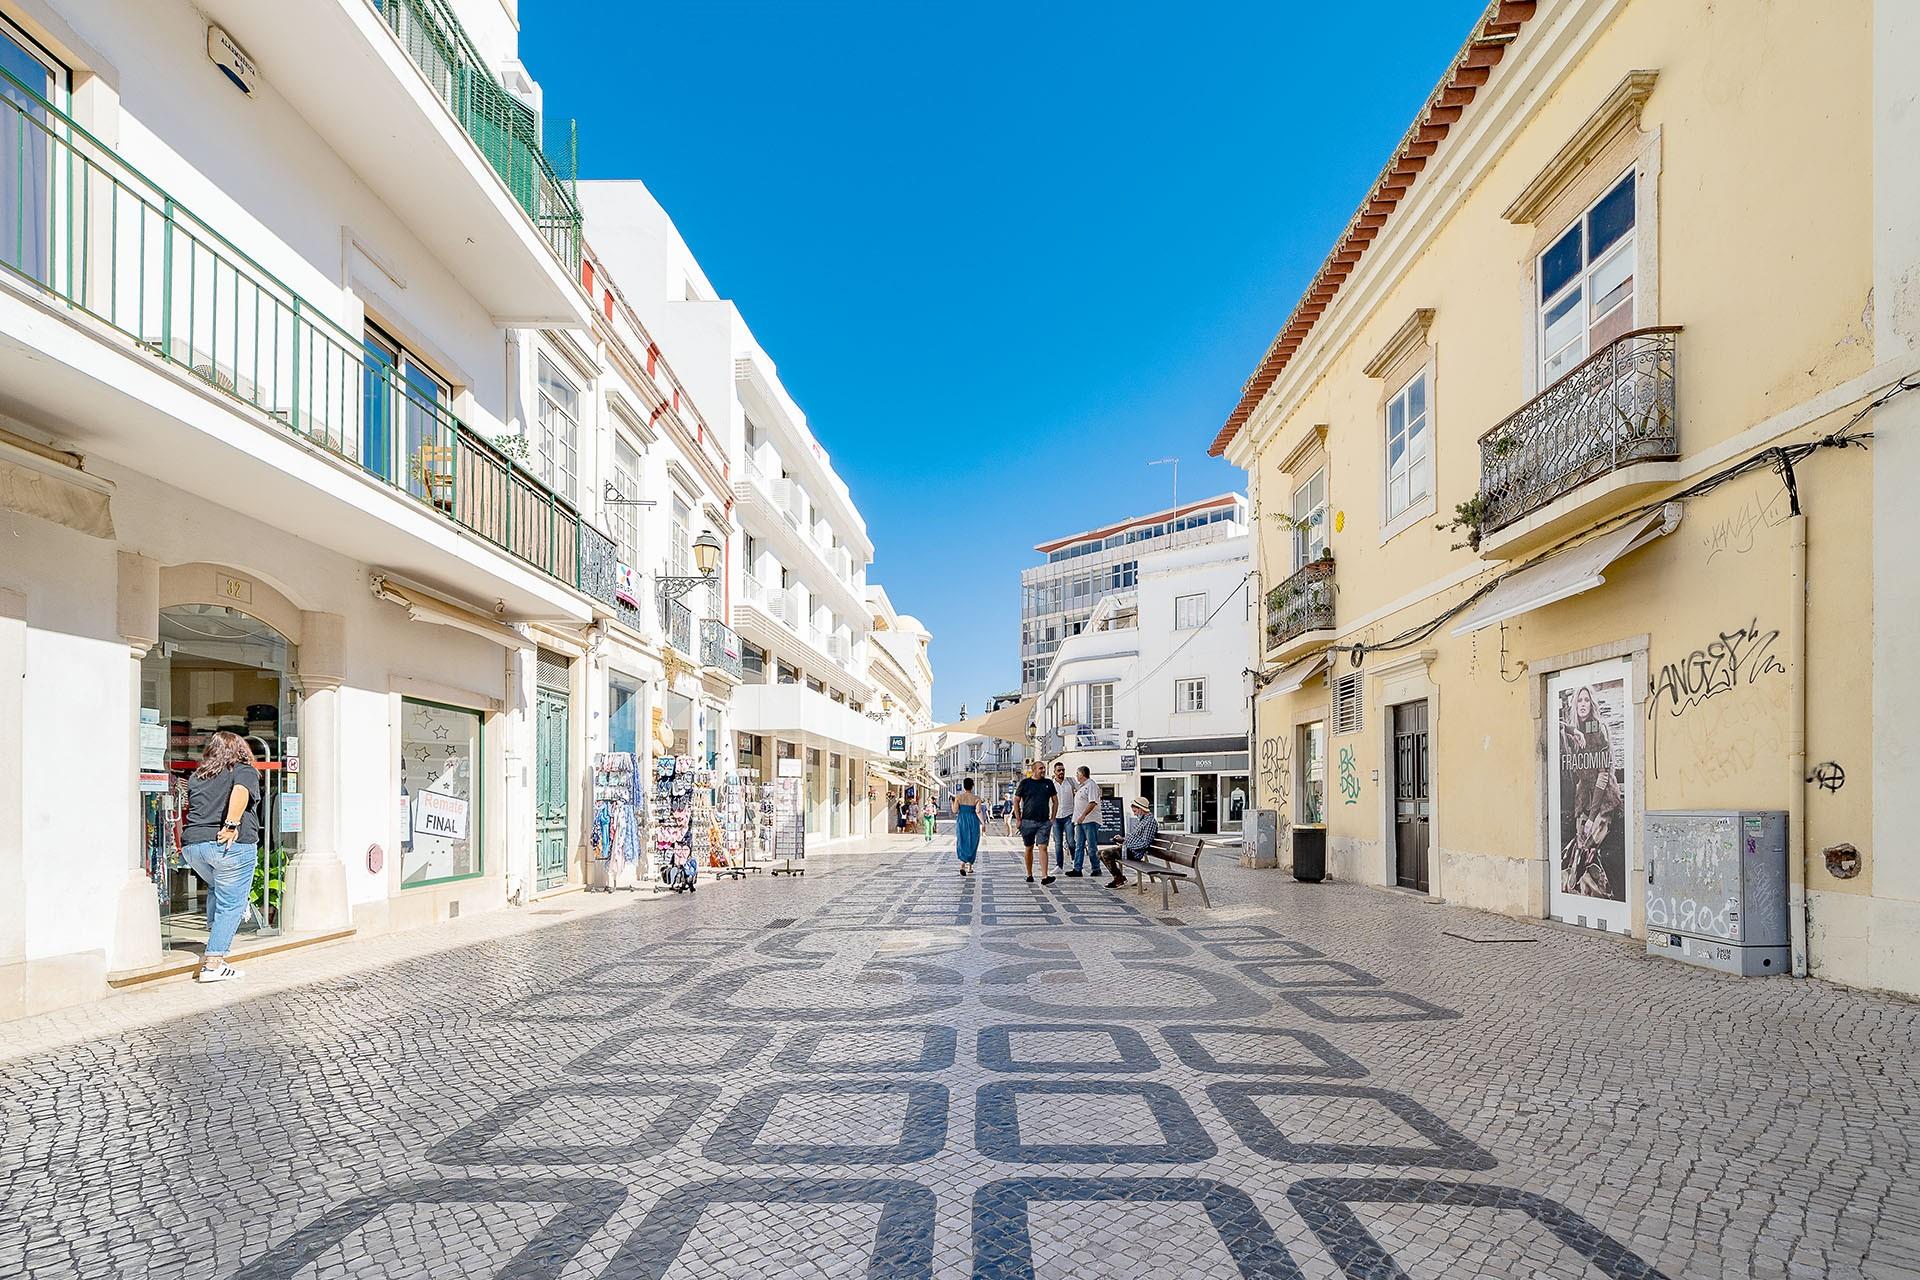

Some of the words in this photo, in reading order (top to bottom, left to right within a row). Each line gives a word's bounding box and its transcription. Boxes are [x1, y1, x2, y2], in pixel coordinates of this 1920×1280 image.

[226, 579, 241, 598] 32
[1195, 759, 1212, 768] BOSS
[1561, 751, 1613, 770] FRACOMINA
[424, 792, 464, 814] Remate
[426, 814, 458, 833] FINAL
